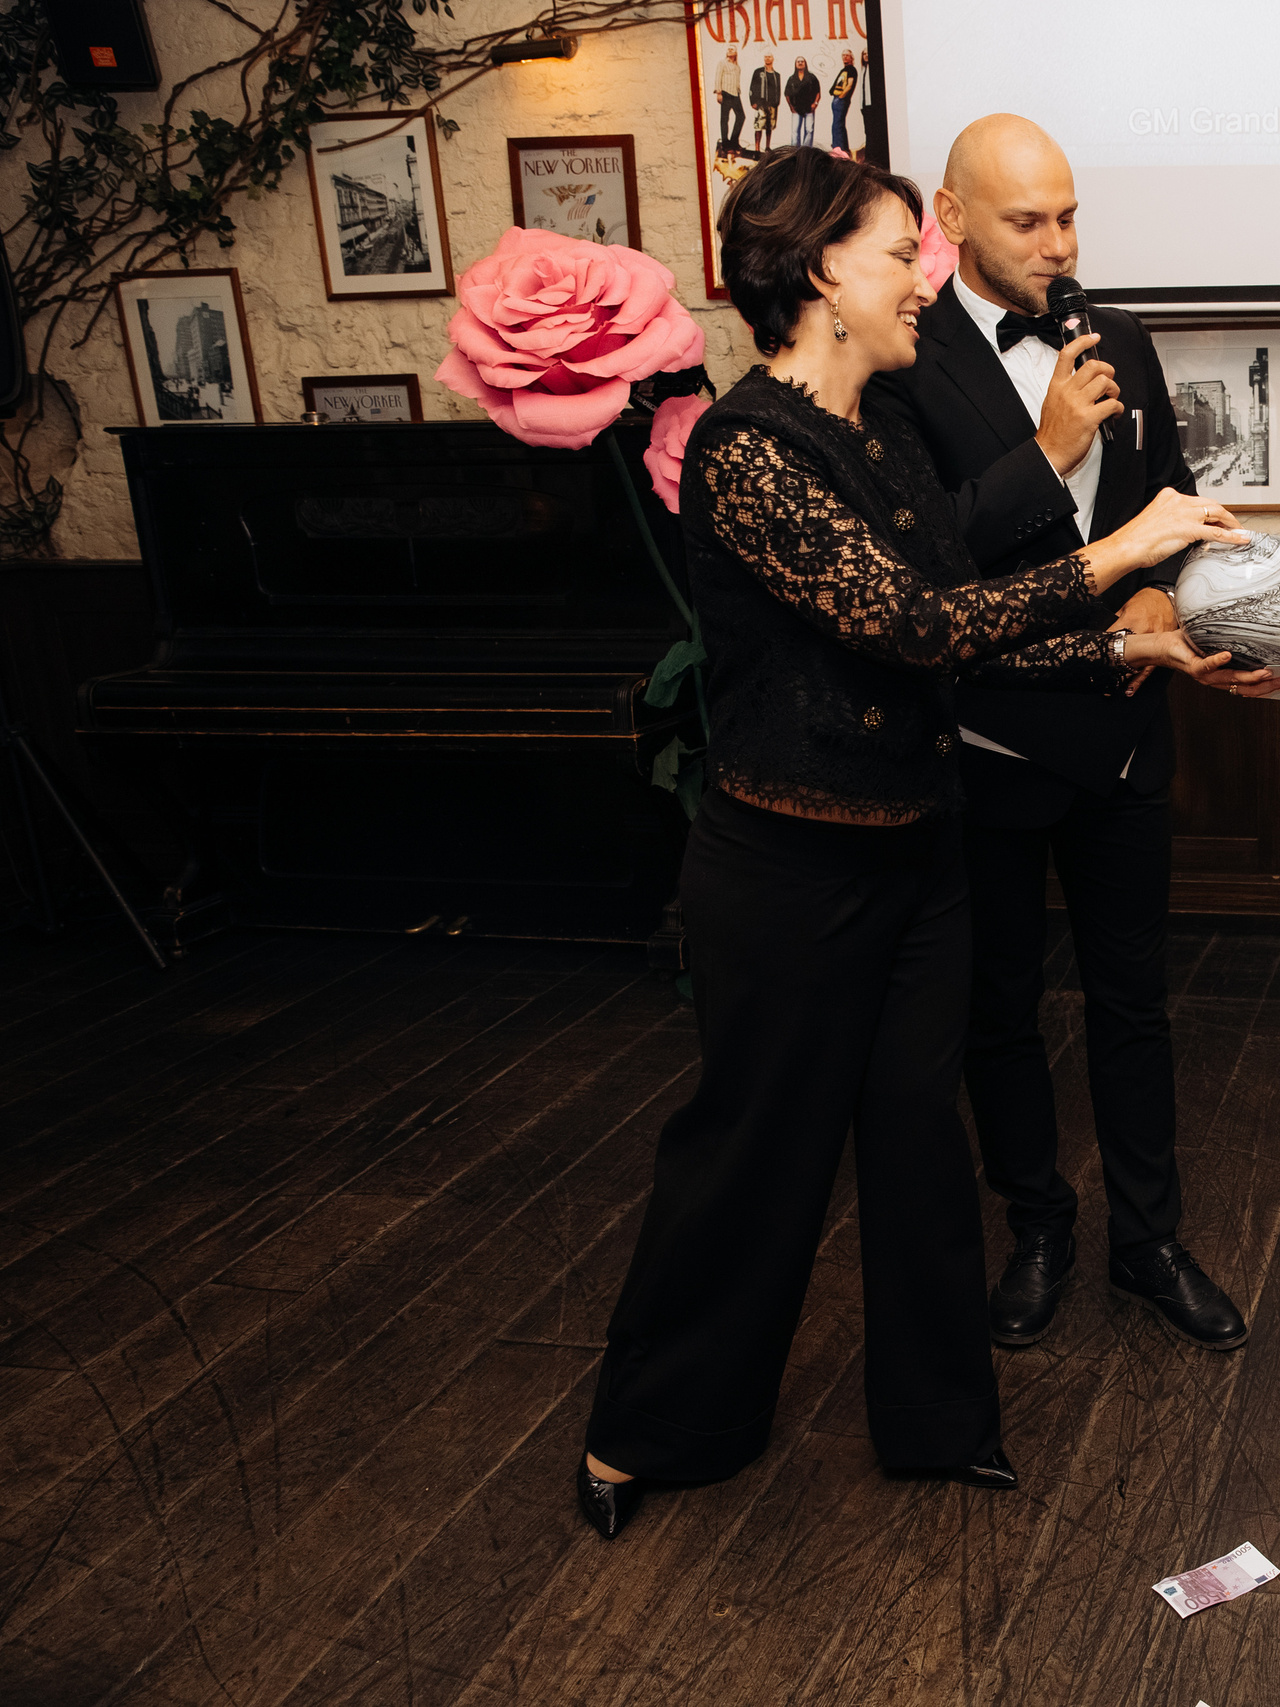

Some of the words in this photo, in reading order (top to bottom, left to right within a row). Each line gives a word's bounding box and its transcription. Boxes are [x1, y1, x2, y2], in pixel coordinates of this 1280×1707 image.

[1127, 107, 1180, 135] GM
[561, 149, 577, 157] THE
[524, 159, 559, 176] NEW
[561, 157, 621, 175] YORKER
[324, 396, 351, 410] NEW
[353, 394, 403, 409] YORKER
